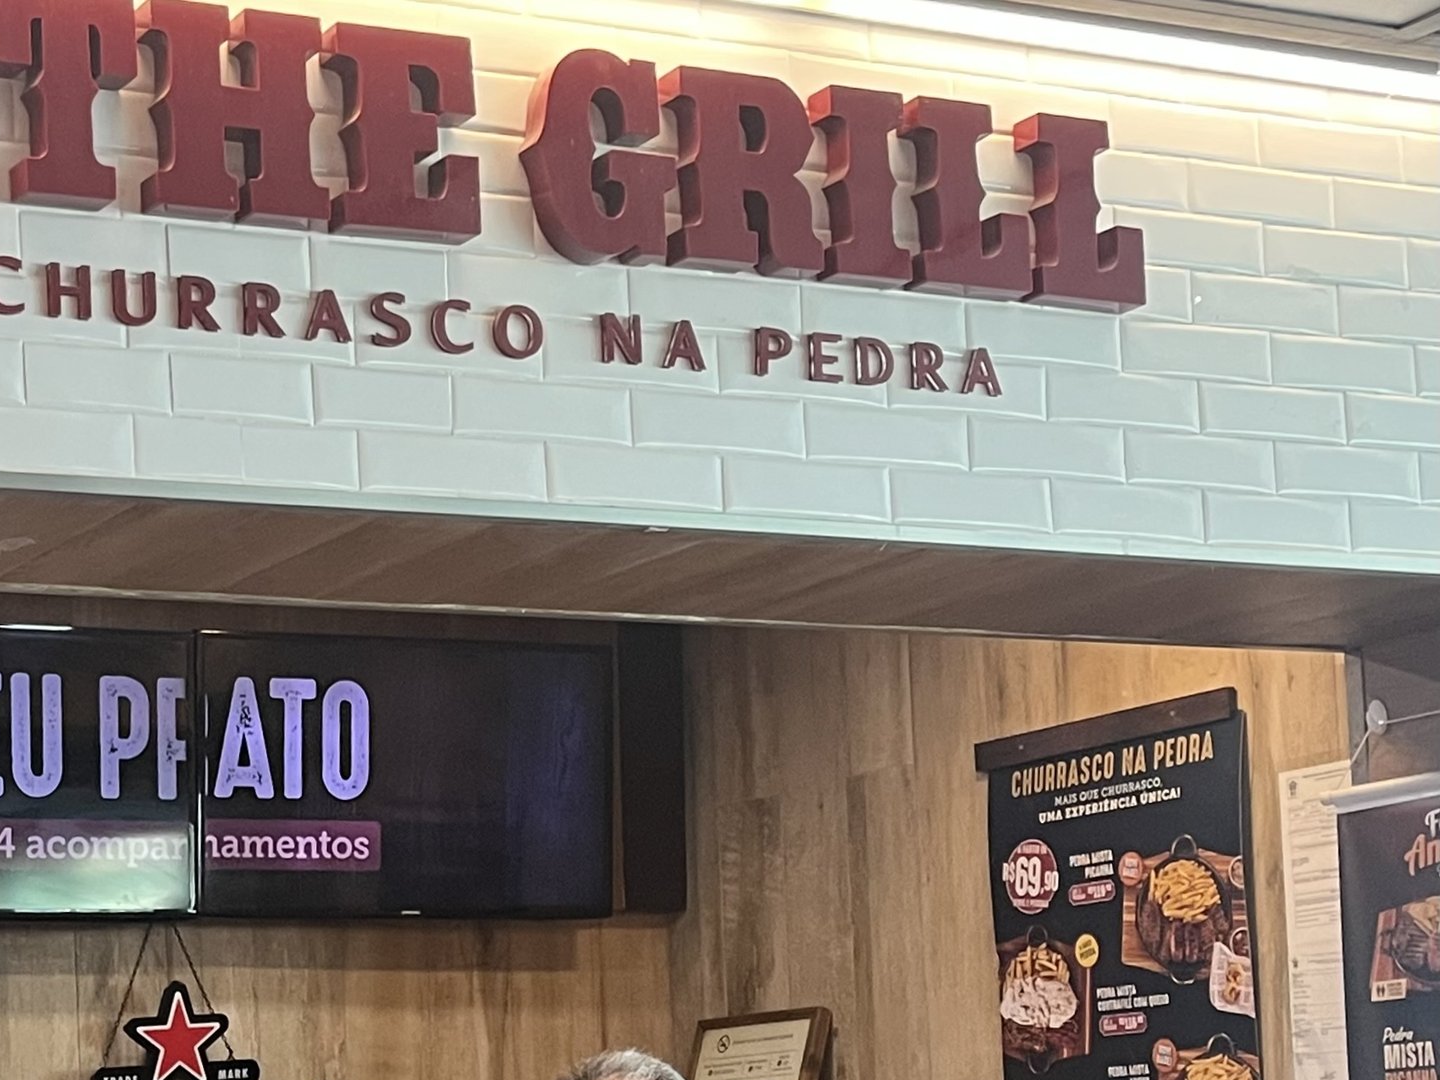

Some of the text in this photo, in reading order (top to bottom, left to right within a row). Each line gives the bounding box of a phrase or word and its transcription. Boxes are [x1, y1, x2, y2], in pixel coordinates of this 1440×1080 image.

[517, 47, 1146, 313] GRILL
[599, 311, 707, 372] NA
[754, 326, 1004, 398] PEDRA
[1011, 731, 1213, 798] CHURRASCO NA PEDRA
[1039, 787, 1180, 824] UMA EXPERIÊNCIA ÚNICA!
[1054, 792, 1078, 806] MAIS
[1079, 788, 1099, 801] QUE
[1382, 1026, 1414, 1043] Pedra
[1383, 1041, 1436, 1070] MISTA
[217, 1068, 249, 1080] MARK
